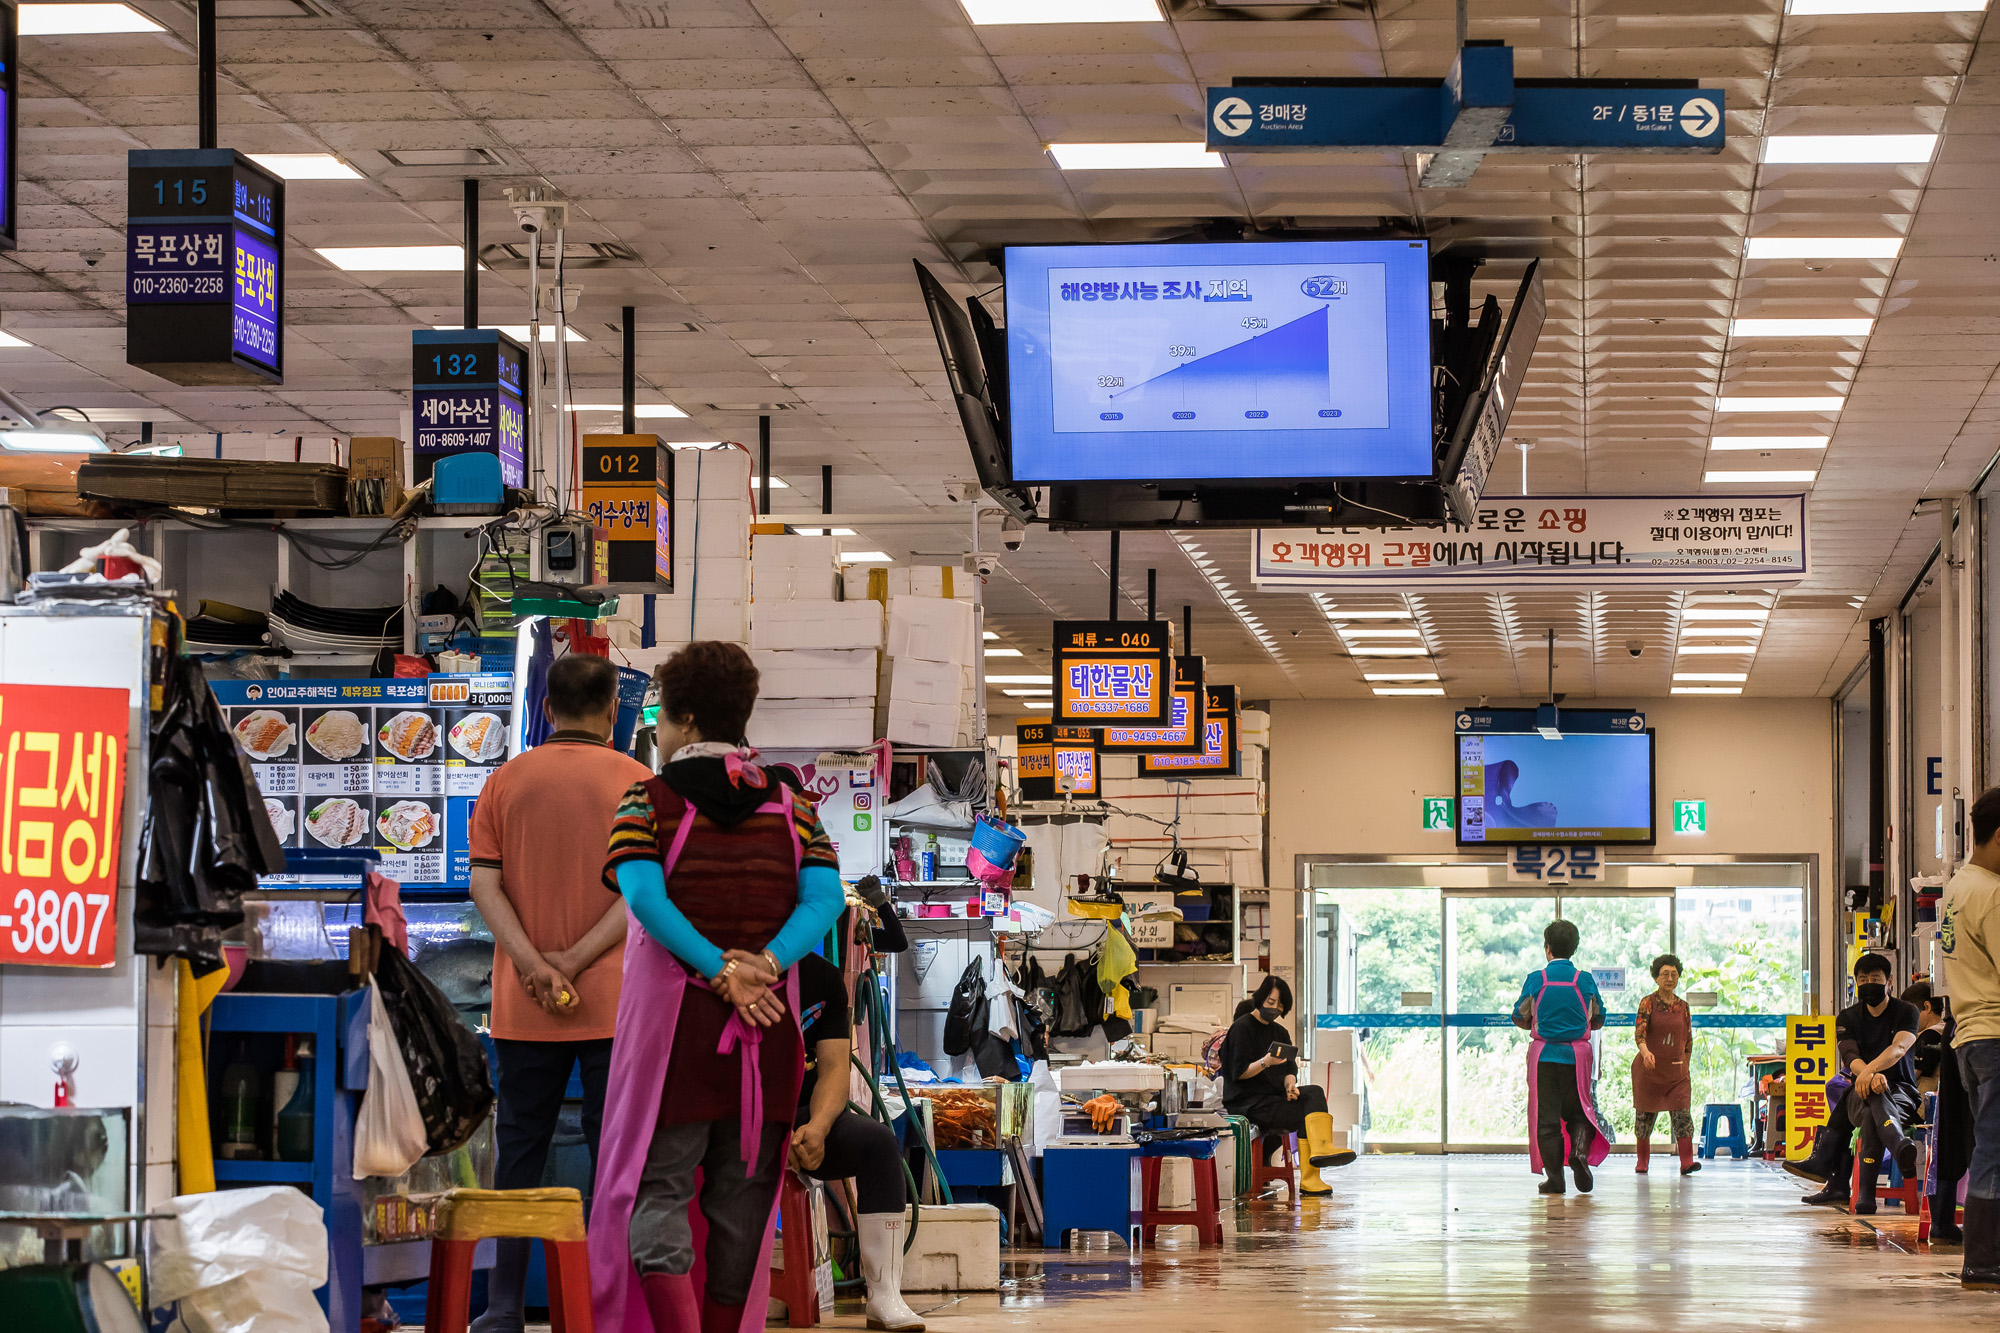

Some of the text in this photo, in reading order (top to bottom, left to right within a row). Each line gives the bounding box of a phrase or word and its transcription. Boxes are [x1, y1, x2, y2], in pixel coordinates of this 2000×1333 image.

[1259, 104, 1307, 121] 경매장
[1593, 105, 1613, 120] 2F
[1632, 105, 1675, 122] 동1문
[1260, 123, 1304, 131] Auction Area
[154, 179, 207, 205] 115
[257, 193, 271, 223] 115
[135, 234, 223, 265] 목포상회
[133, 277, 224, 294] 010-2360-2258
[235, 246, 275, 312] 목포상회
[1305, 276, 1348, 296] 52개
[1060, 279, 1249, 301] 해양방사능 조사 지역
[1241, 317, 1268, 330] 45개
[234, 314, 275, 357] 010-2360-2258
[1169, 345, 1196, 357] 39개
[432, 354, 478, 376] 132
[1097, 376, 1124, 388] 32개
[420, 398, 491, 424] 세아수산
[419, 433, 491, 447] 010-8609-1407
[600, 455, 639, 473] 012
[588, 500, 650, 529] 여수상회
[1537, 508, 1587, 533] 쇼핑
[1739, 508, 1782, 522] 점포는
[1650, 524, 1793, 541] 절대 이용하지 맙시다!
[1270, 541, 1631, 568] 호객행위 근절에서 시작됩니다.
[1734, 547, 1768, 555] 신고센터
[1072, 633, 1098, 647] 패류
[1121, 633, 1150, 647] 040
[1070, 664, 1152, 699] 태한물산
[266, 685, 427, 699] 인어교주해적단 제휴점포 목포상회
[1071, 703, 1150, 713] 010-5337-1686
[1024, 729, 1044, 740] 055
[1077, 728, 1090, 738] 055
[1111, 731, 1186, 742] 010-9459-4667
[1020, 753, 1051, 771] 미정상회
[1057, 751, 1093, 778] 미정상회
[1153, 756, 1222, 766] 010-3185-9756
[308, 771, 335, 780] 대광어회
[2, 731, 117, 885] (금성)
[380, 860, 408, 868] 다익선회
[1512, 845, 1600, 880] 북2문
